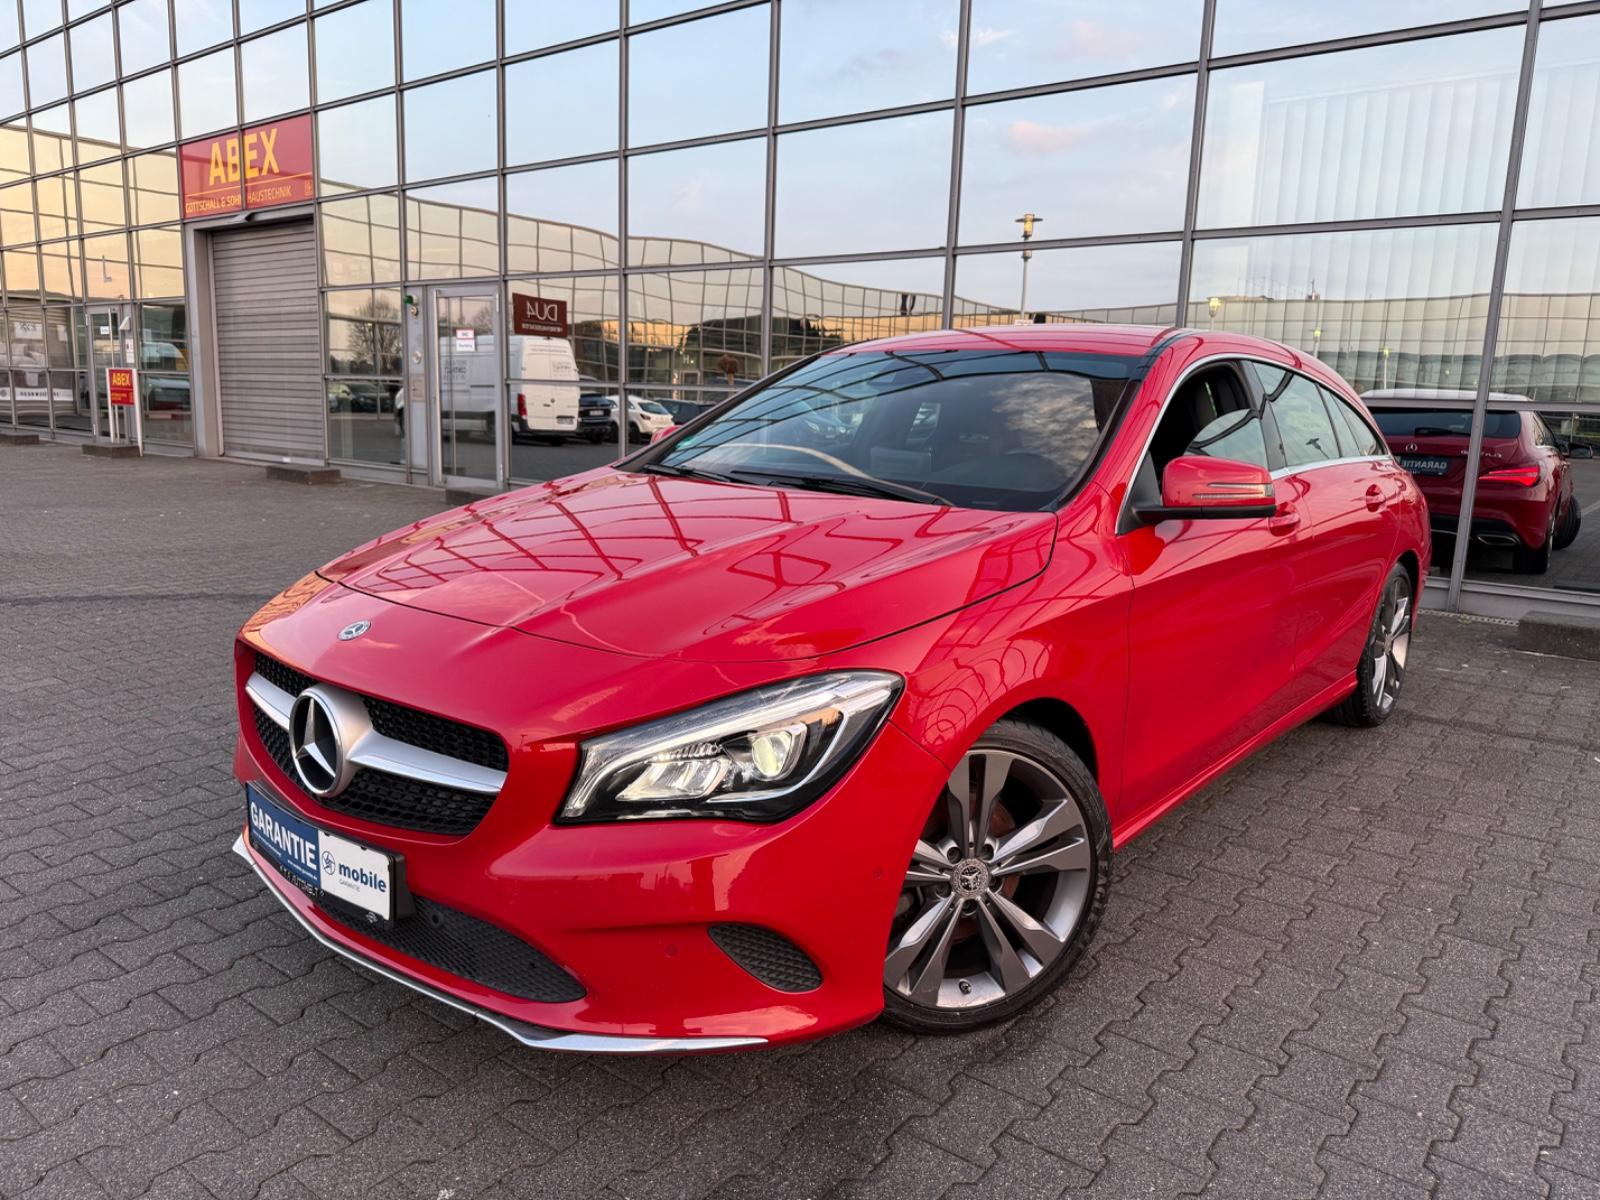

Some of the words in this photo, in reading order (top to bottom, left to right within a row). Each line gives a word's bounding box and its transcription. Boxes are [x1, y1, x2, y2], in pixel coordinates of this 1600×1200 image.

[209, 128, 280, 186] ABEX
[185, 198, 220, 213] GOTTSCHALL
[248, 186, 291, 203] HAUSTECHNIK
[112, 372, 131, 387] ABEX
[251, 802, 317, 870] GARANTIE
[338, 861, 387, 893] mobile
